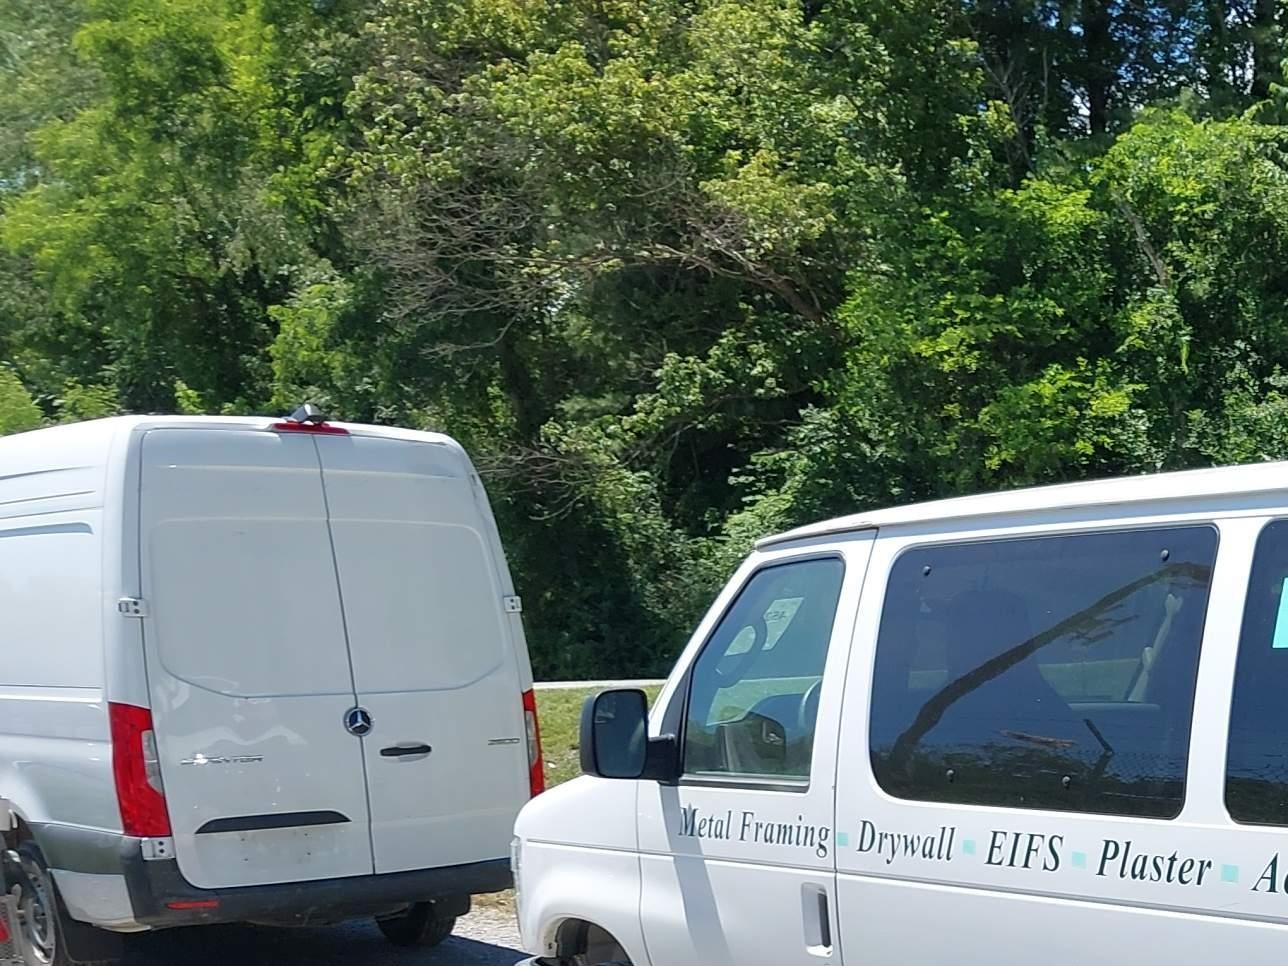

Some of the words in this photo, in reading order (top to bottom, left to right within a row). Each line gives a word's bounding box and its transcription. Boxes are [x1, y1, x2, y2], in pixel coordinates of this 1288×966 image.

[678, 803, 732, 841] Metal
[738, 811, 831, 858] Framing
[855, 819, 956, 865] Drywall
[983, 830, 1065, 872] EIFS
[1095, 839, 1213, 886] Plaster
